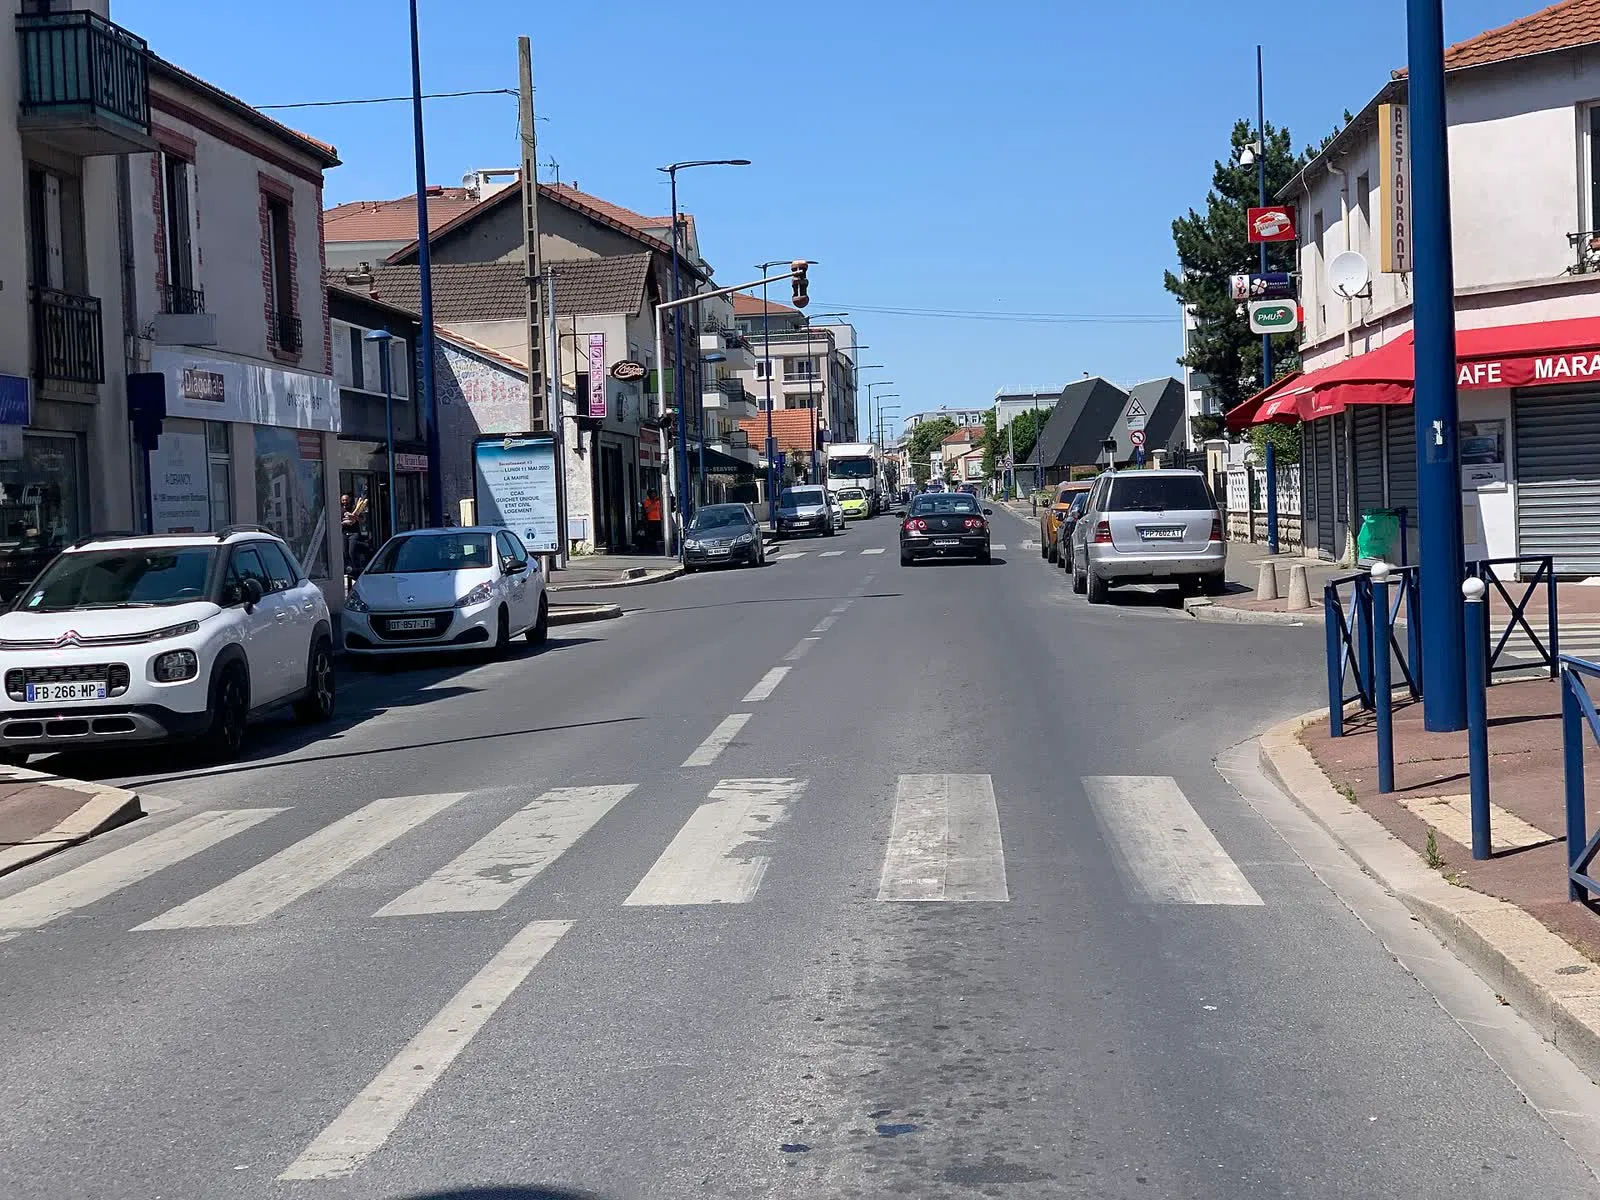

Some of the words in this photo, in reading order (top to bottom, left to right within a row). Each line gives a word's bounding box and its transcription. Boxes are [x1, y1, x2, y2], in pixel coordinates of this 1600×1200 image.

[1395, 107, 1405, 269] RESTAURANT
[1257, 313, 1277, 321] PMU
[184, 370, 224, 399] Diagonale
[1457, 362, 1502, 385] AFE
